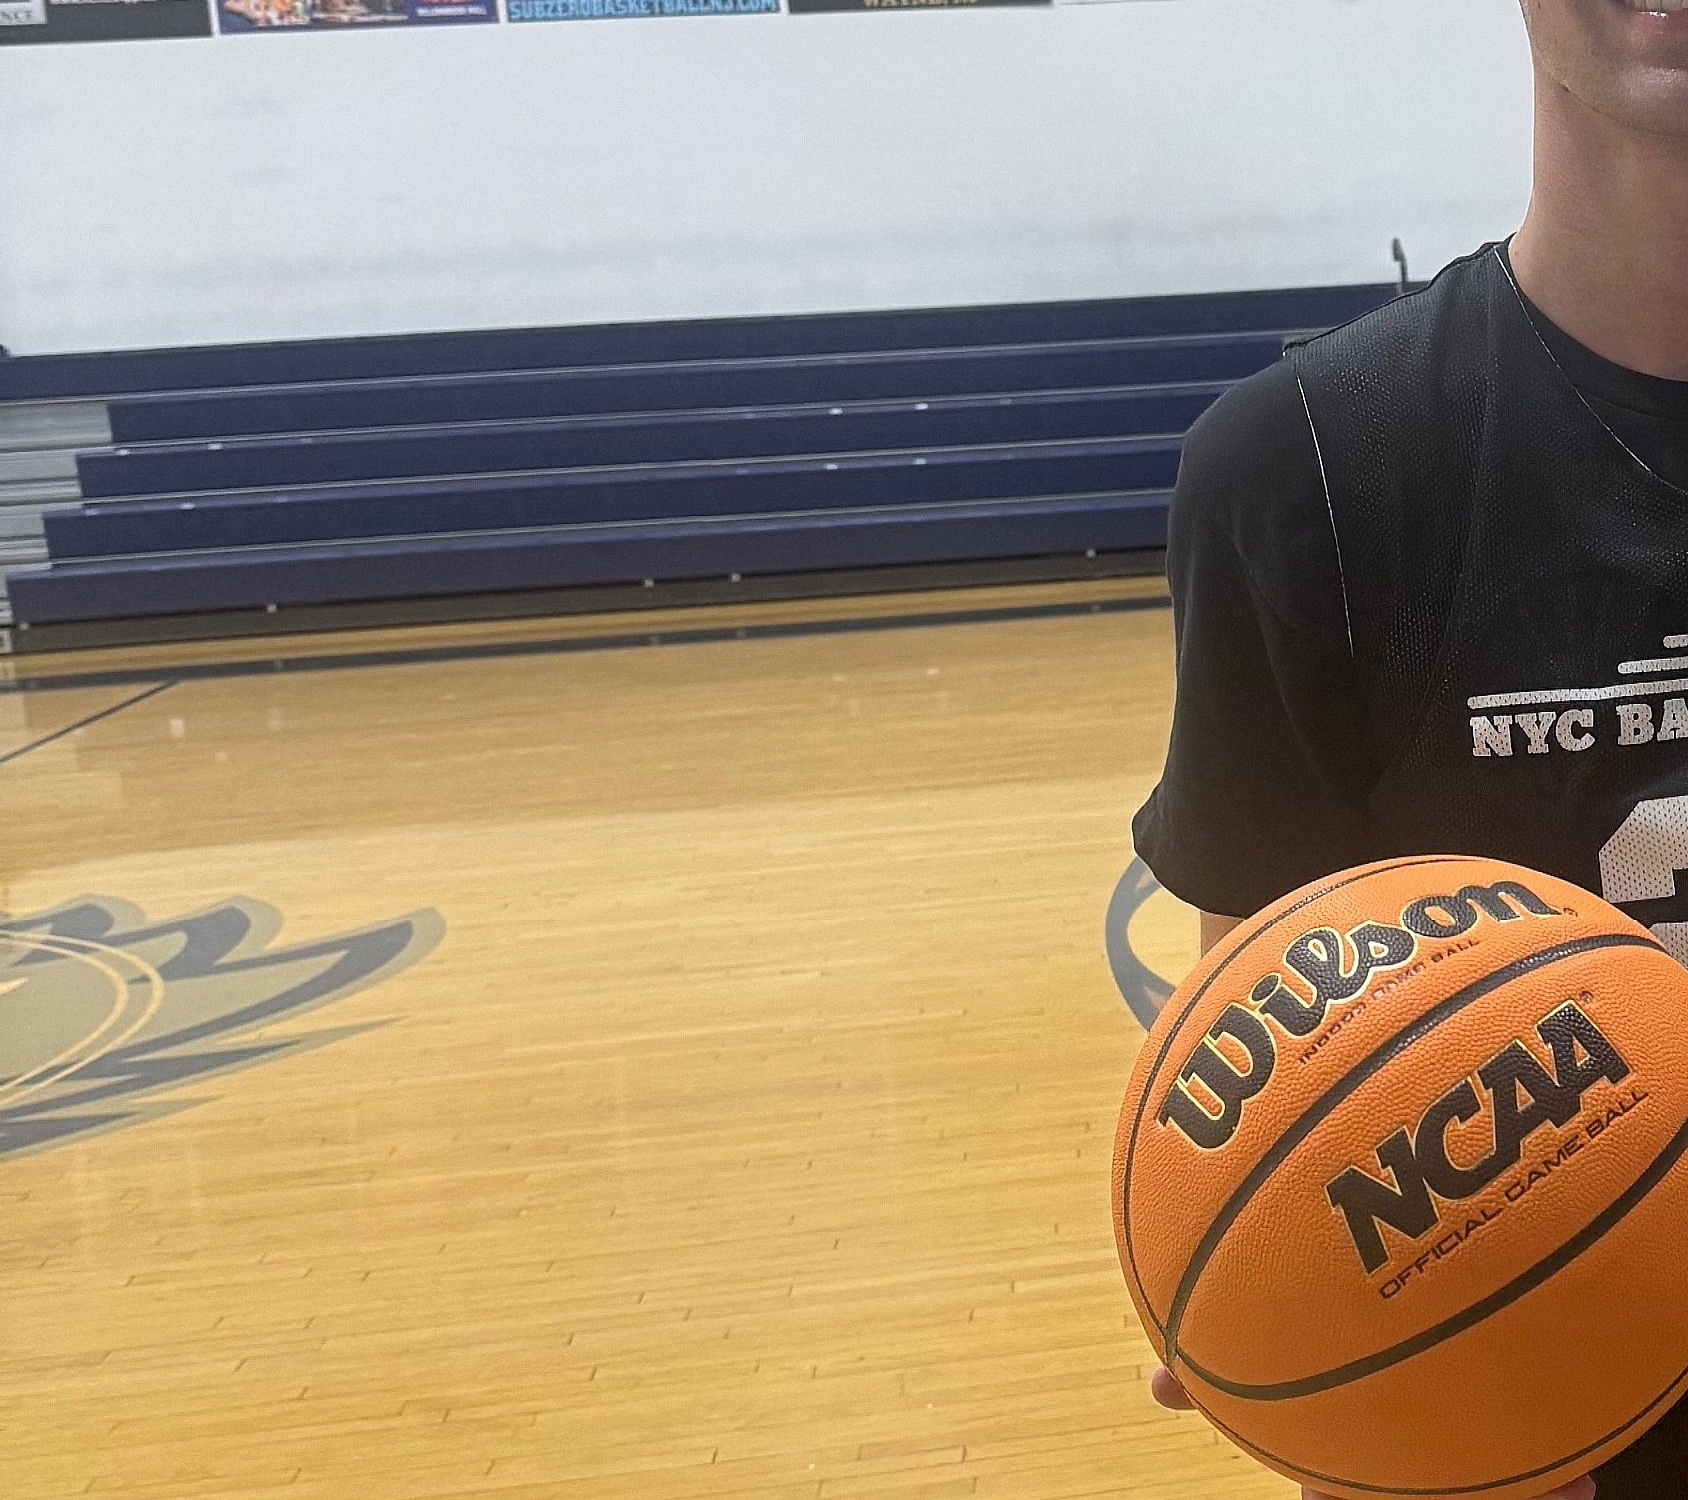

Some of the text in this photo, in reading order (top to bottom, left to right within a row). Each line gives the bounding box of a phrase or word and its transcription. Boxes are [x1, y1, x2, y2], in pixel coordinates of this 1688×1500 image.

[1469, 709, 1595, 757] NYC
[1157, 879, 1563, 1149] Wilson
[1300, 1002, 1367, 1065] INDOOR
[1431, 938, 1480, 964] BALL
[1323, 999, 1631, 1274] NCAA
[1379, 1091, 1649, 1299] OFFICIAL GAME BALL
